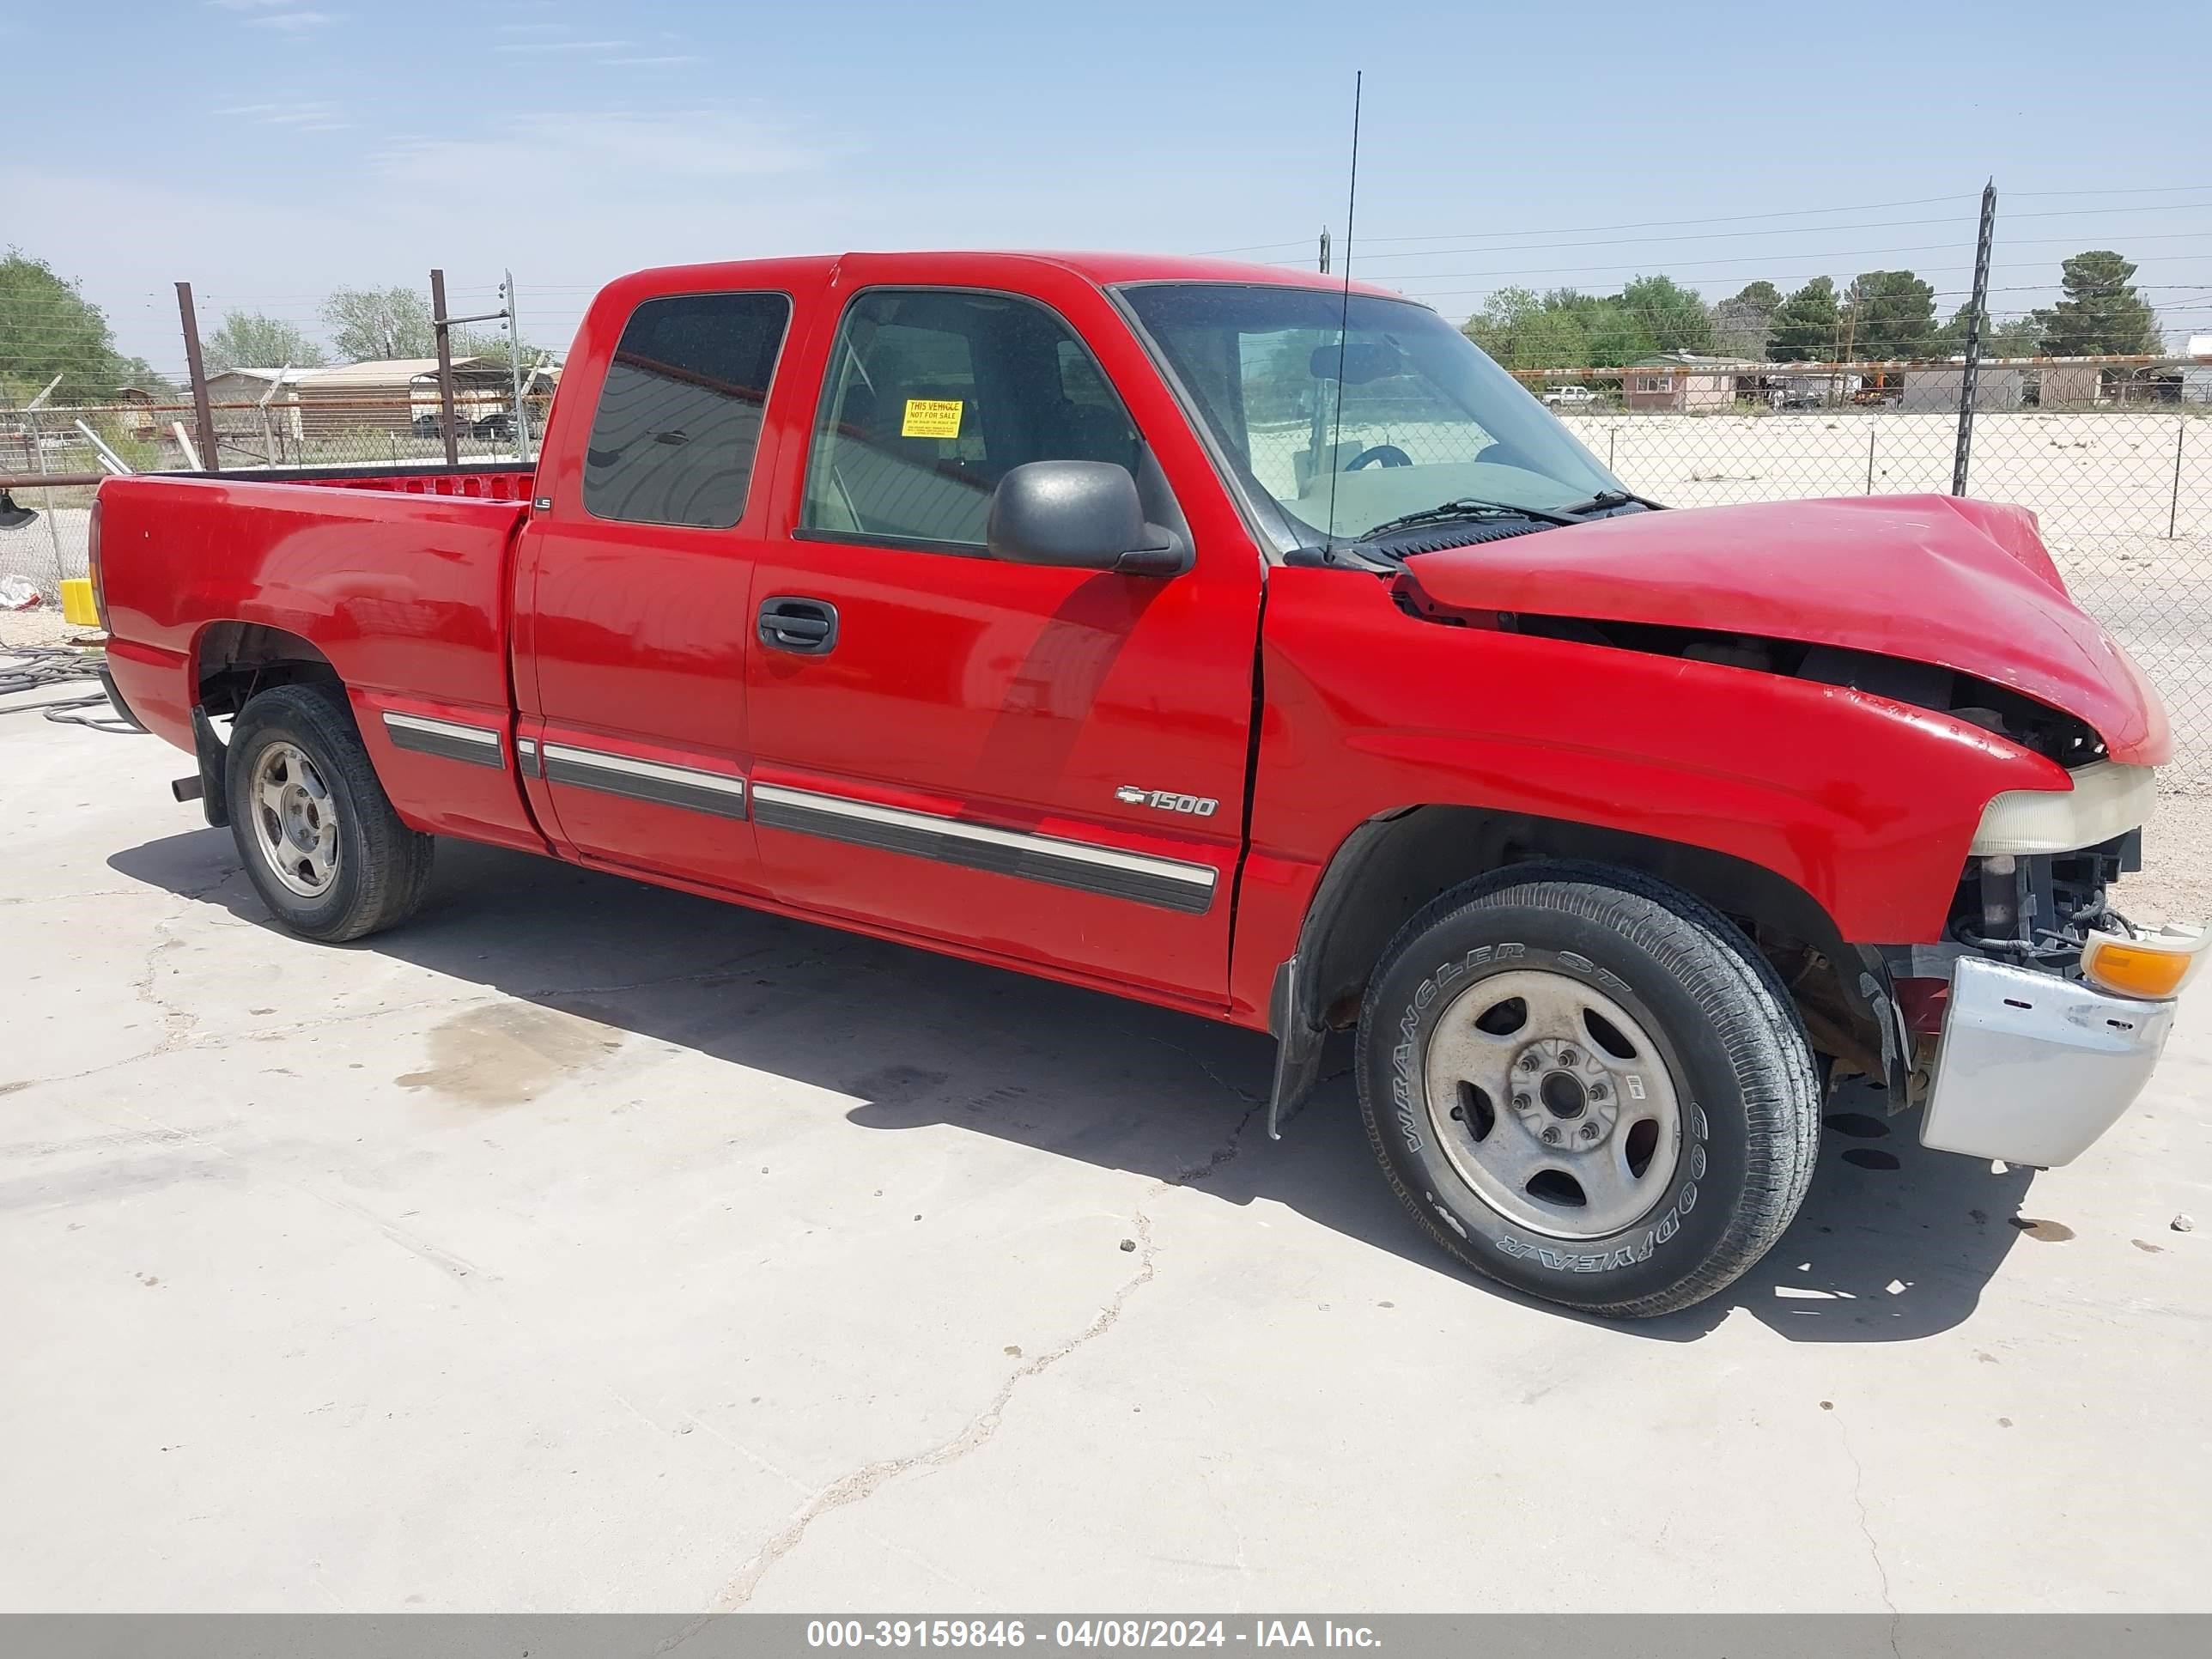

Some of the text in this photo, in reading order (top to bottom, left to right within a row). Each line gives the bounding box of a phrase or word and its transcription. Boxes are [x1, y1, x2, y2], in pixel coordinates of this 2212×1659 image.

[910, 402, 959, 411] THIS VEHICLE
[535, 499, 551, 508] LS
[1150, 791, 1217, 816] 1500
[1393, 942, 1632, 1153] WRANGLER ST
[1495, 1101, 1709, 1273] GOODYEAR
